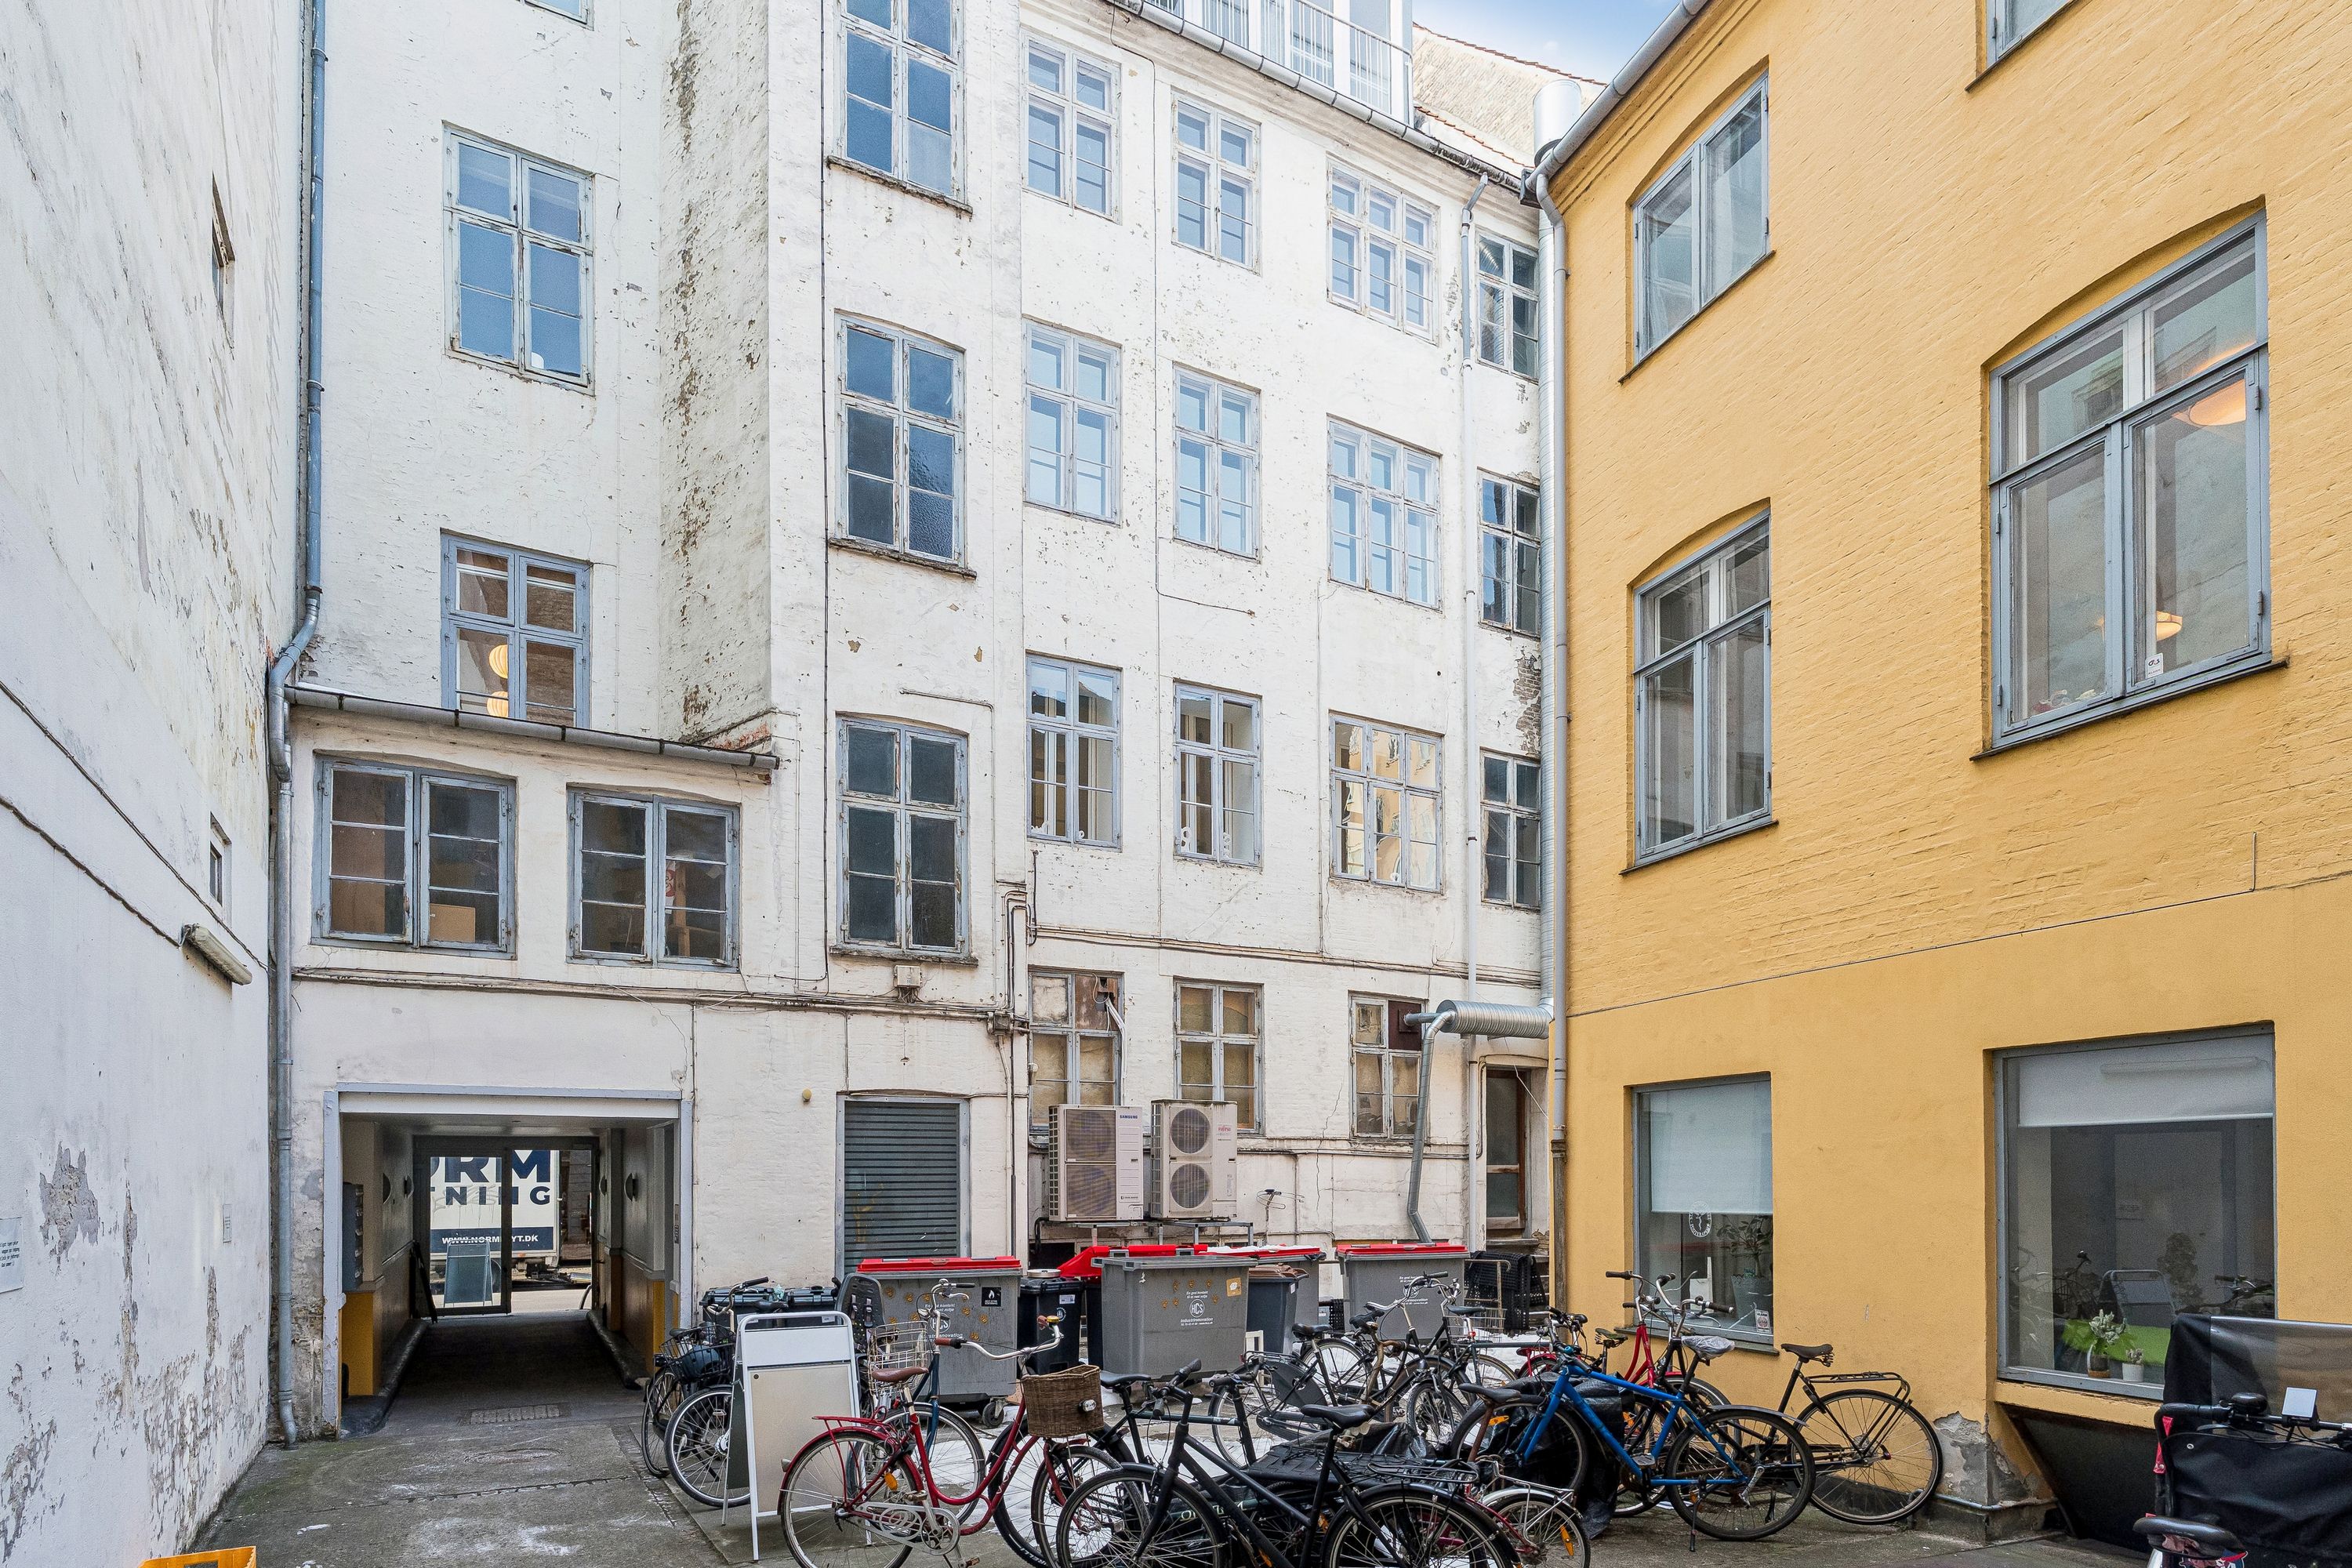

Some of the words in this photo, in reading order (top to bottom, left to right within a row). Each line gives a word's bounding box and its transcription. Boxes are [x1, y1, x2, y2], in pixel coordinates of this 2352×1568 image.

[430, 1150, 550, 1182] RM
[430, 1186, 550, 1205] NIG
[442, 1235, 539, 1244] WWW.NORMYT.DK
[1192, 1303, 1203, 1314] HCS
[1020, 1548, 1047, 1566] IRELLI
